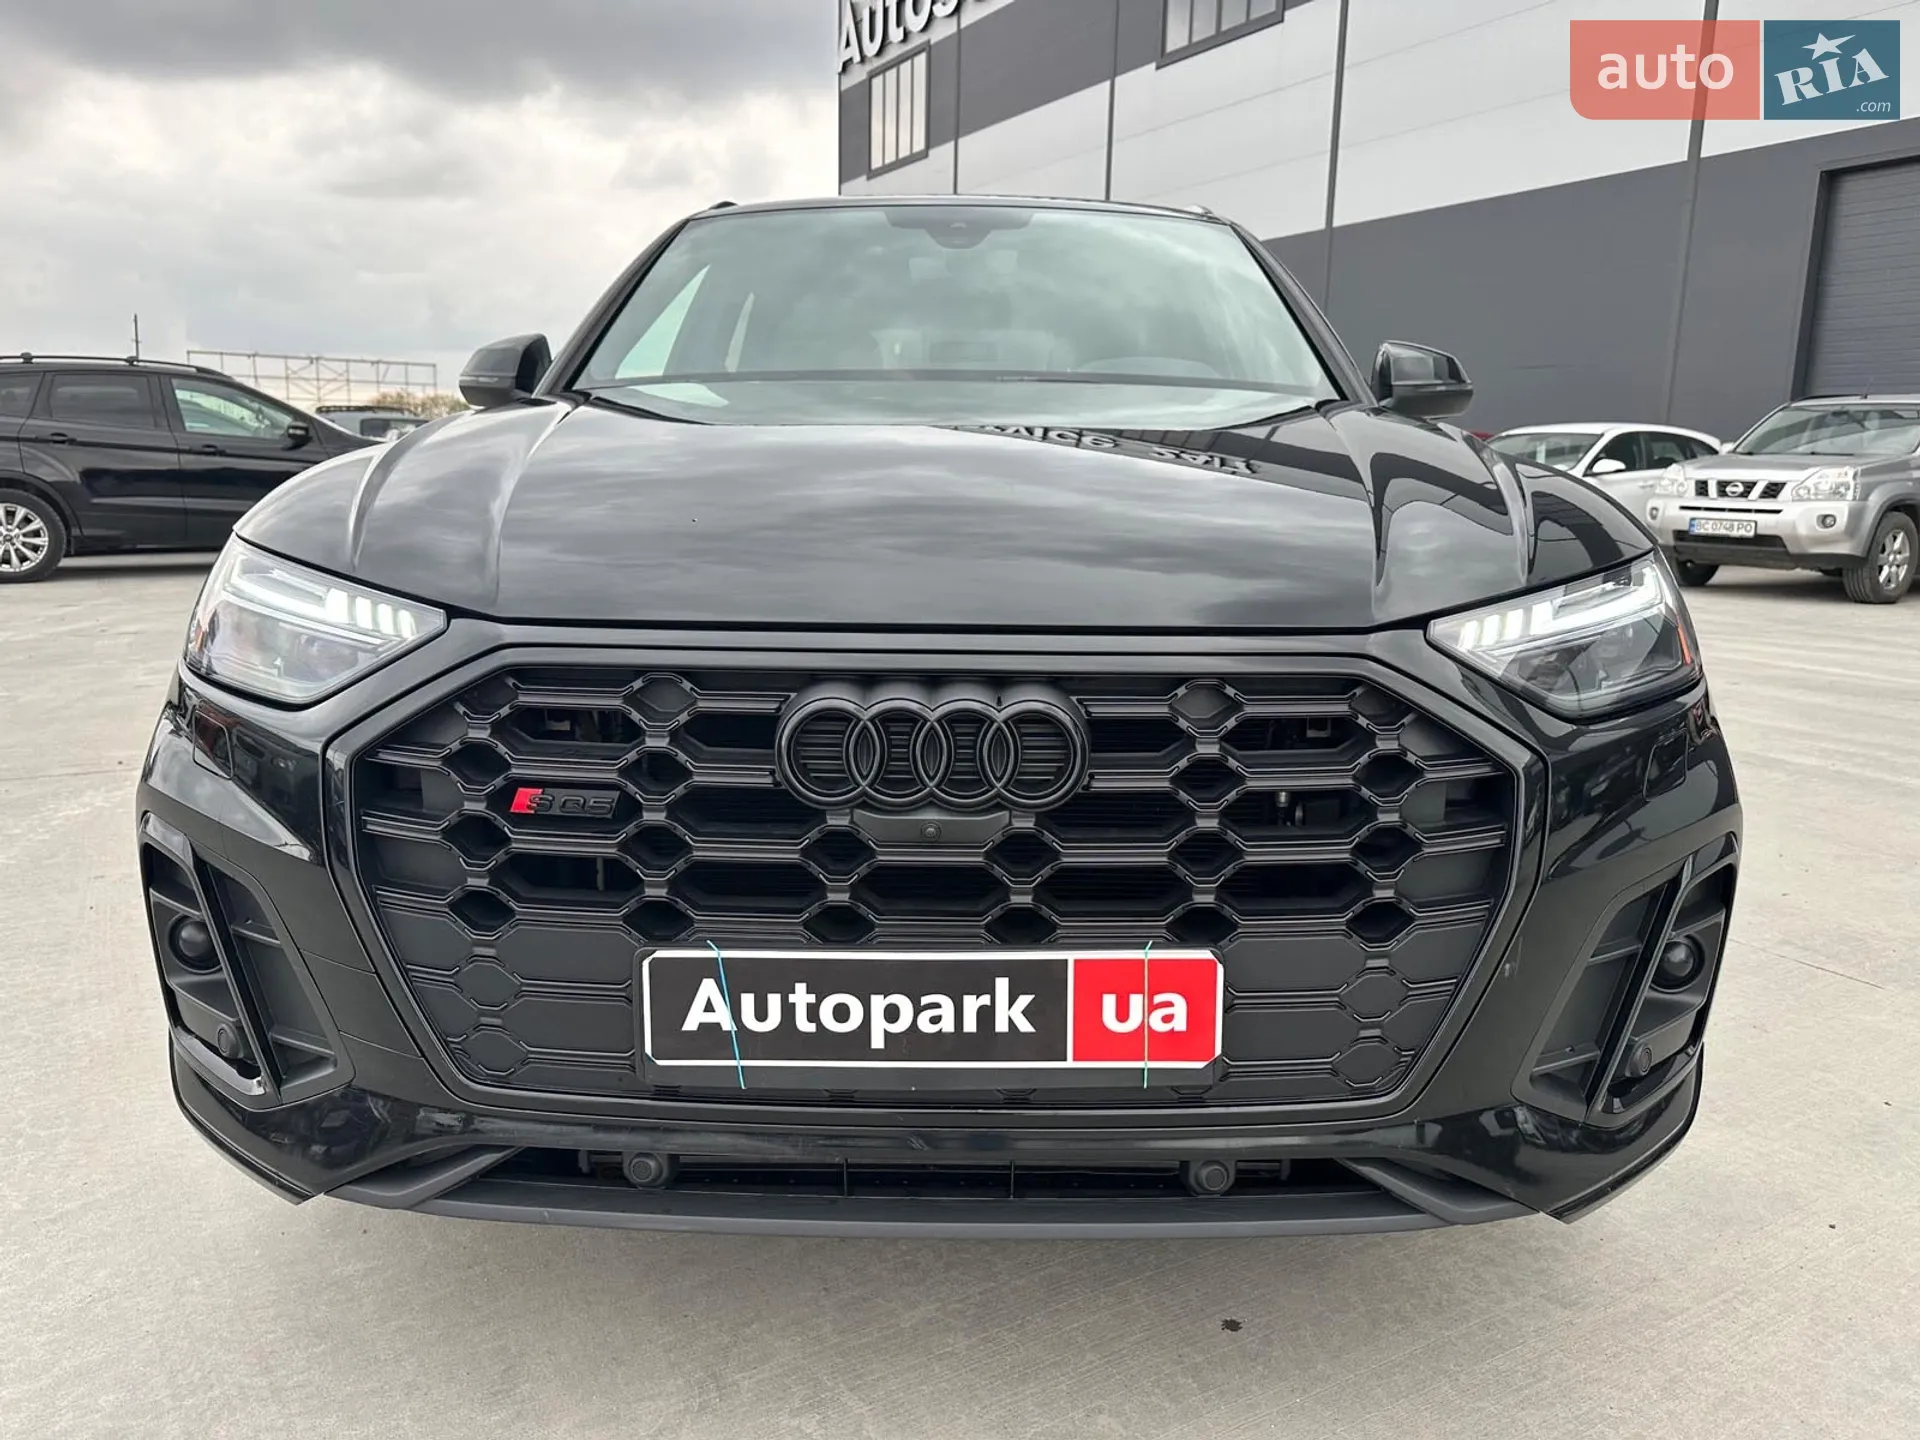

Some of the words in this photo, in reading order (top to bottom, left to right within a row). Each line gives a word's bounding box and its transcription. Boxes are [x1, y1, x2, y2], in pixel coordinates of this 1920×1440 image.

[526, 794, 614, 817] SQ5
[681, 976, 1036, 1049] Autopark
[1101, 992, 1188, 1034] ua
